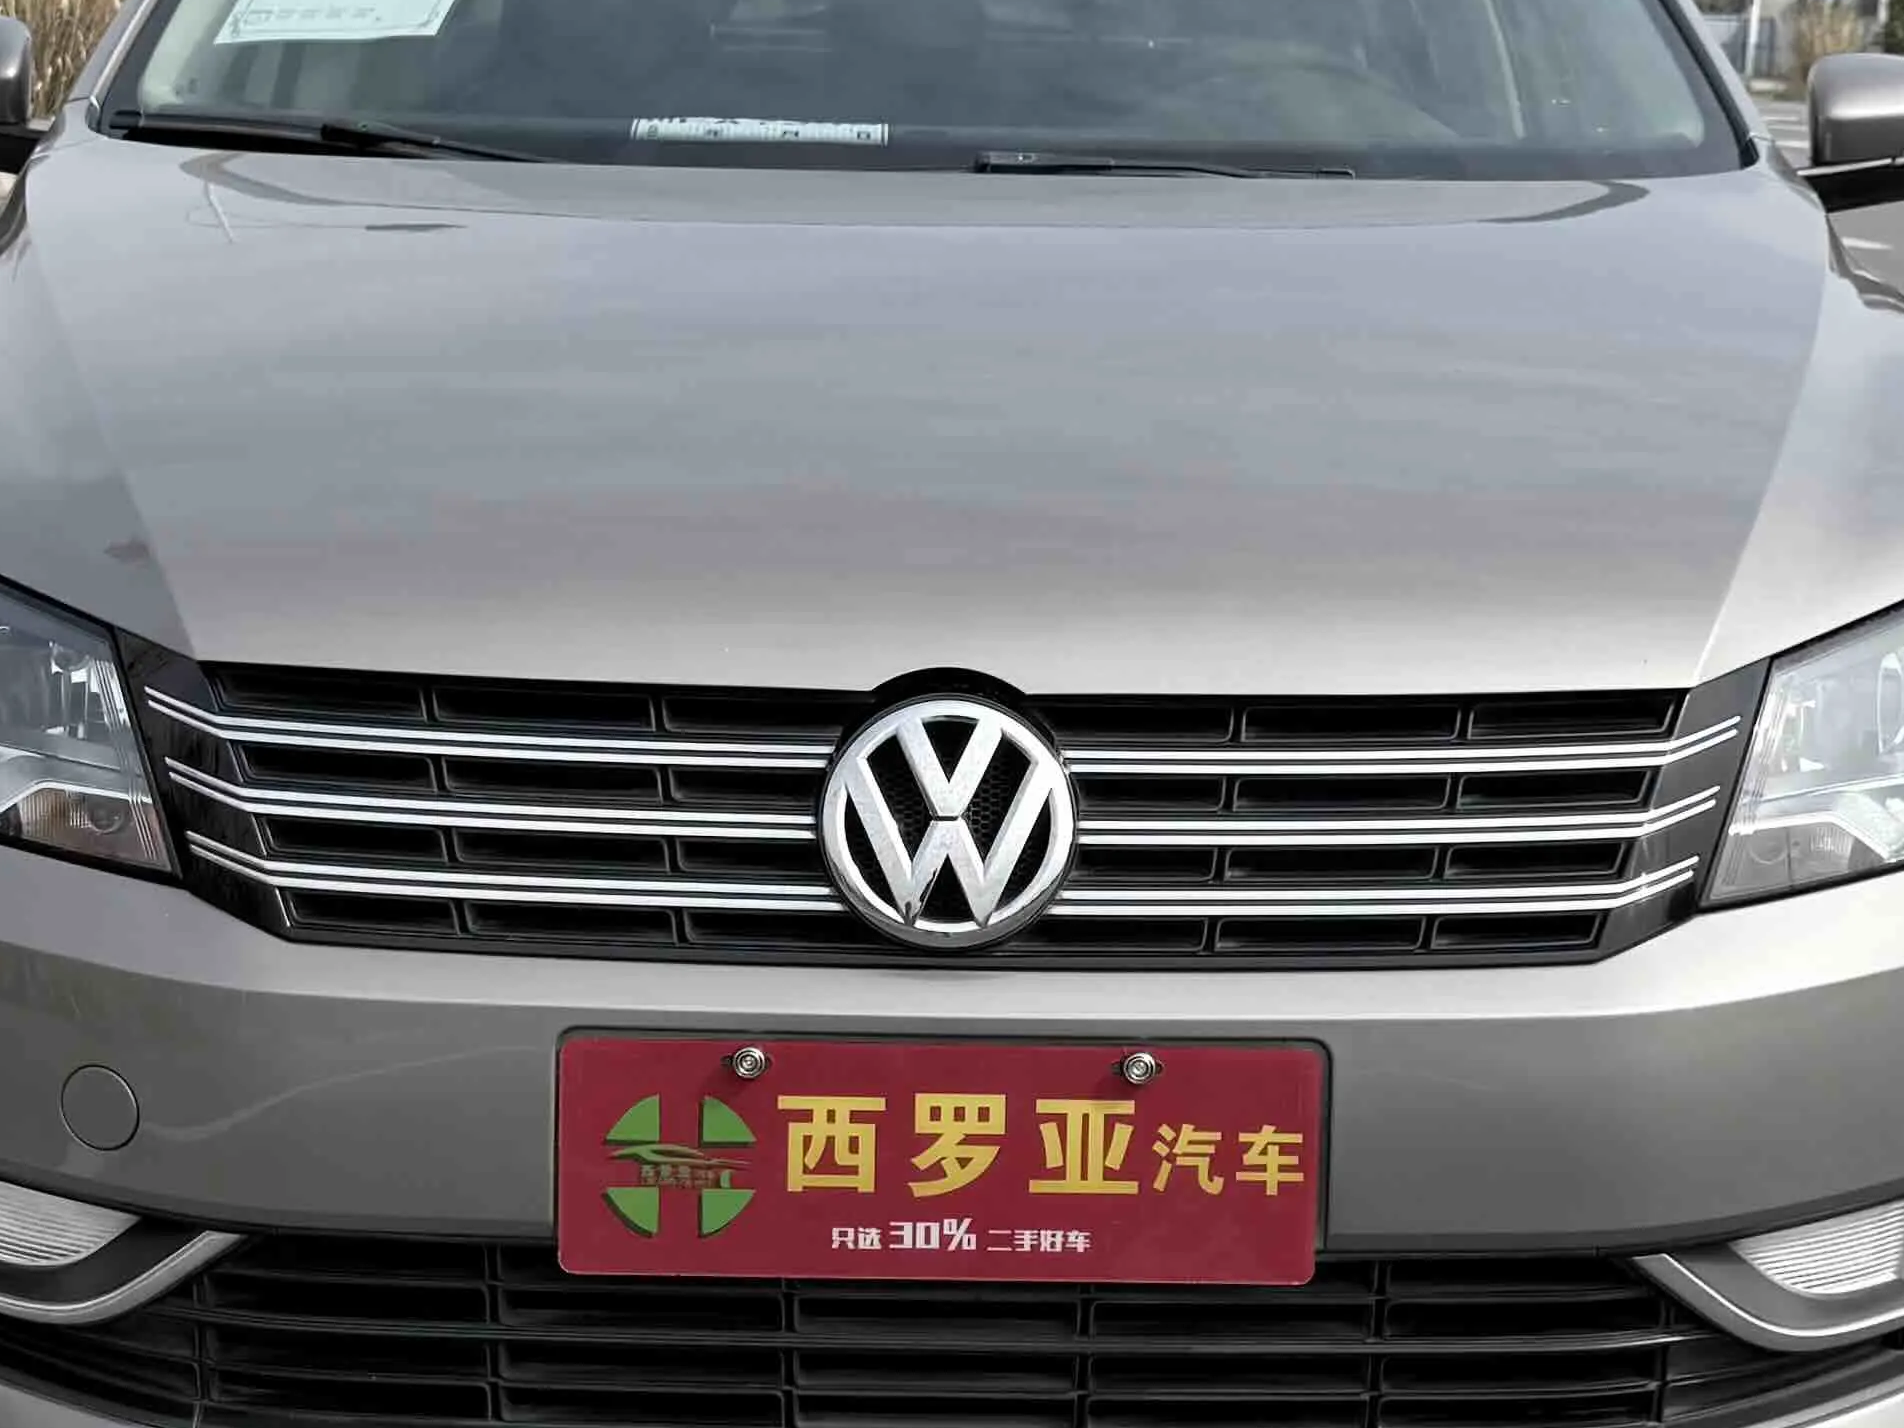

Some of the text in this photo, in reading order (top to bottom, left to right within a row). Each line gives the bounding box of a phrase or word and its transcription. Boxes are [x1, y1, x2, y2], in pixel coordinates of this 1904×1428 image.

[889, 1217, 977, 1251] 30%
[987, 1229, 1092, 1253] 二手好车
